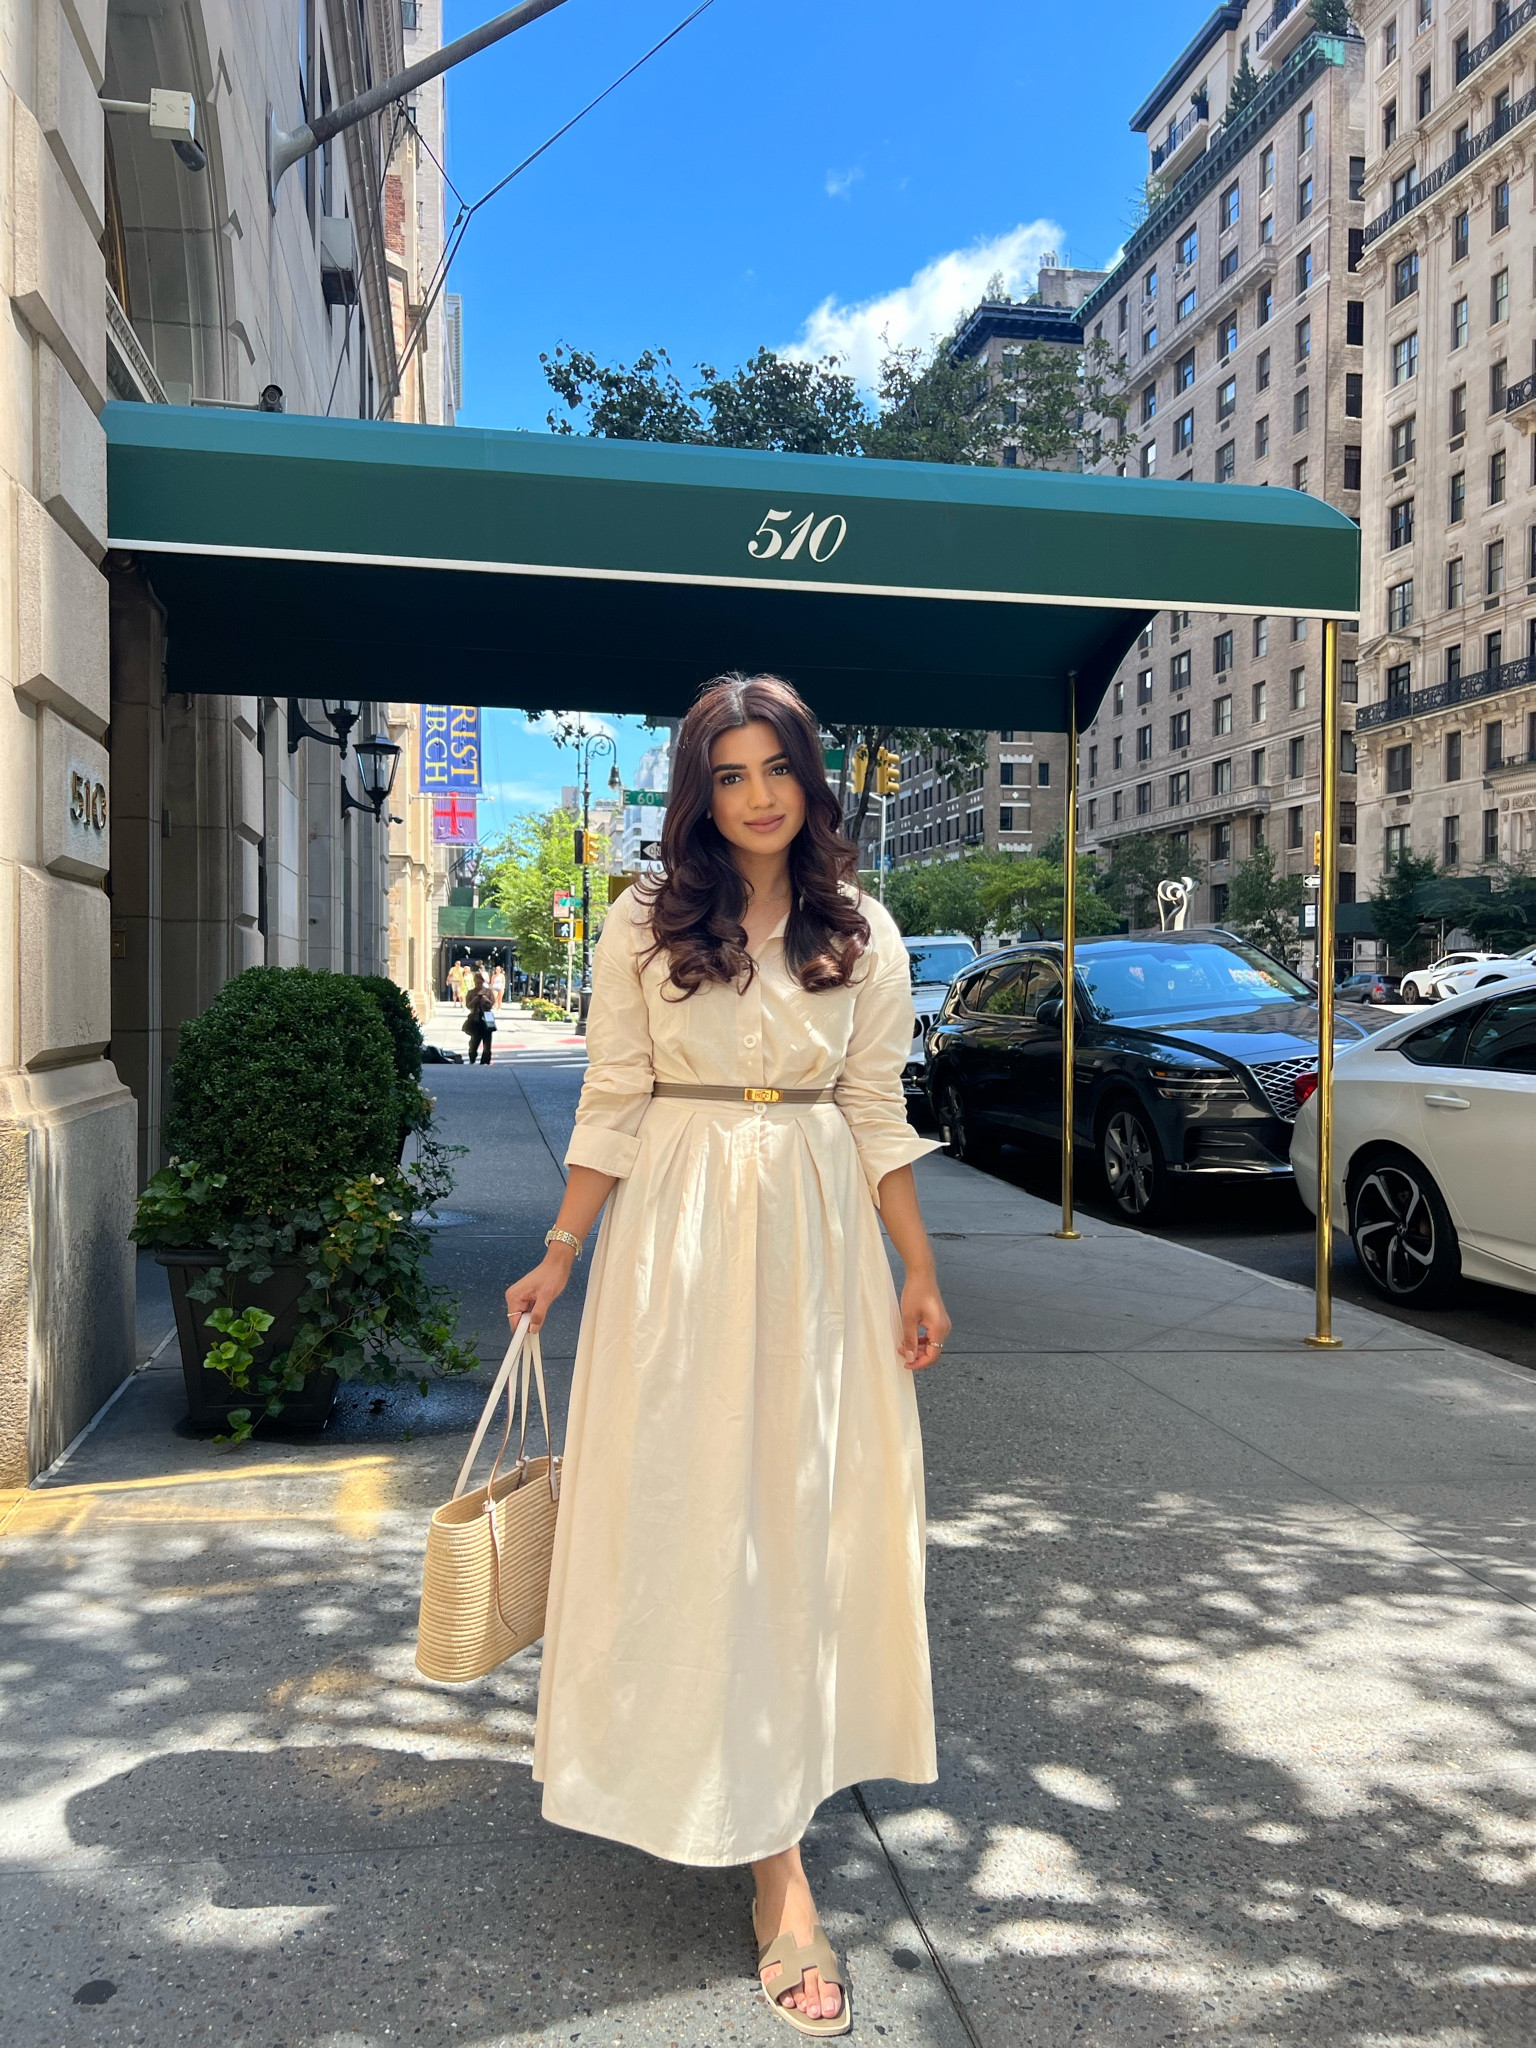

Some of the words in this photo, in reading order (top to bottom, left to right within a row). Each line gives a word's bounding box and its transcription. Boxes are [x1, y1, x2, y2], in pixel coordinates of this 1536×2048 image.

[747, 508, 847, 563] 510
[70, 771, 107, 830] 510
[624, 792, 631, 804] E
[637, 792, 654, 805] 60
